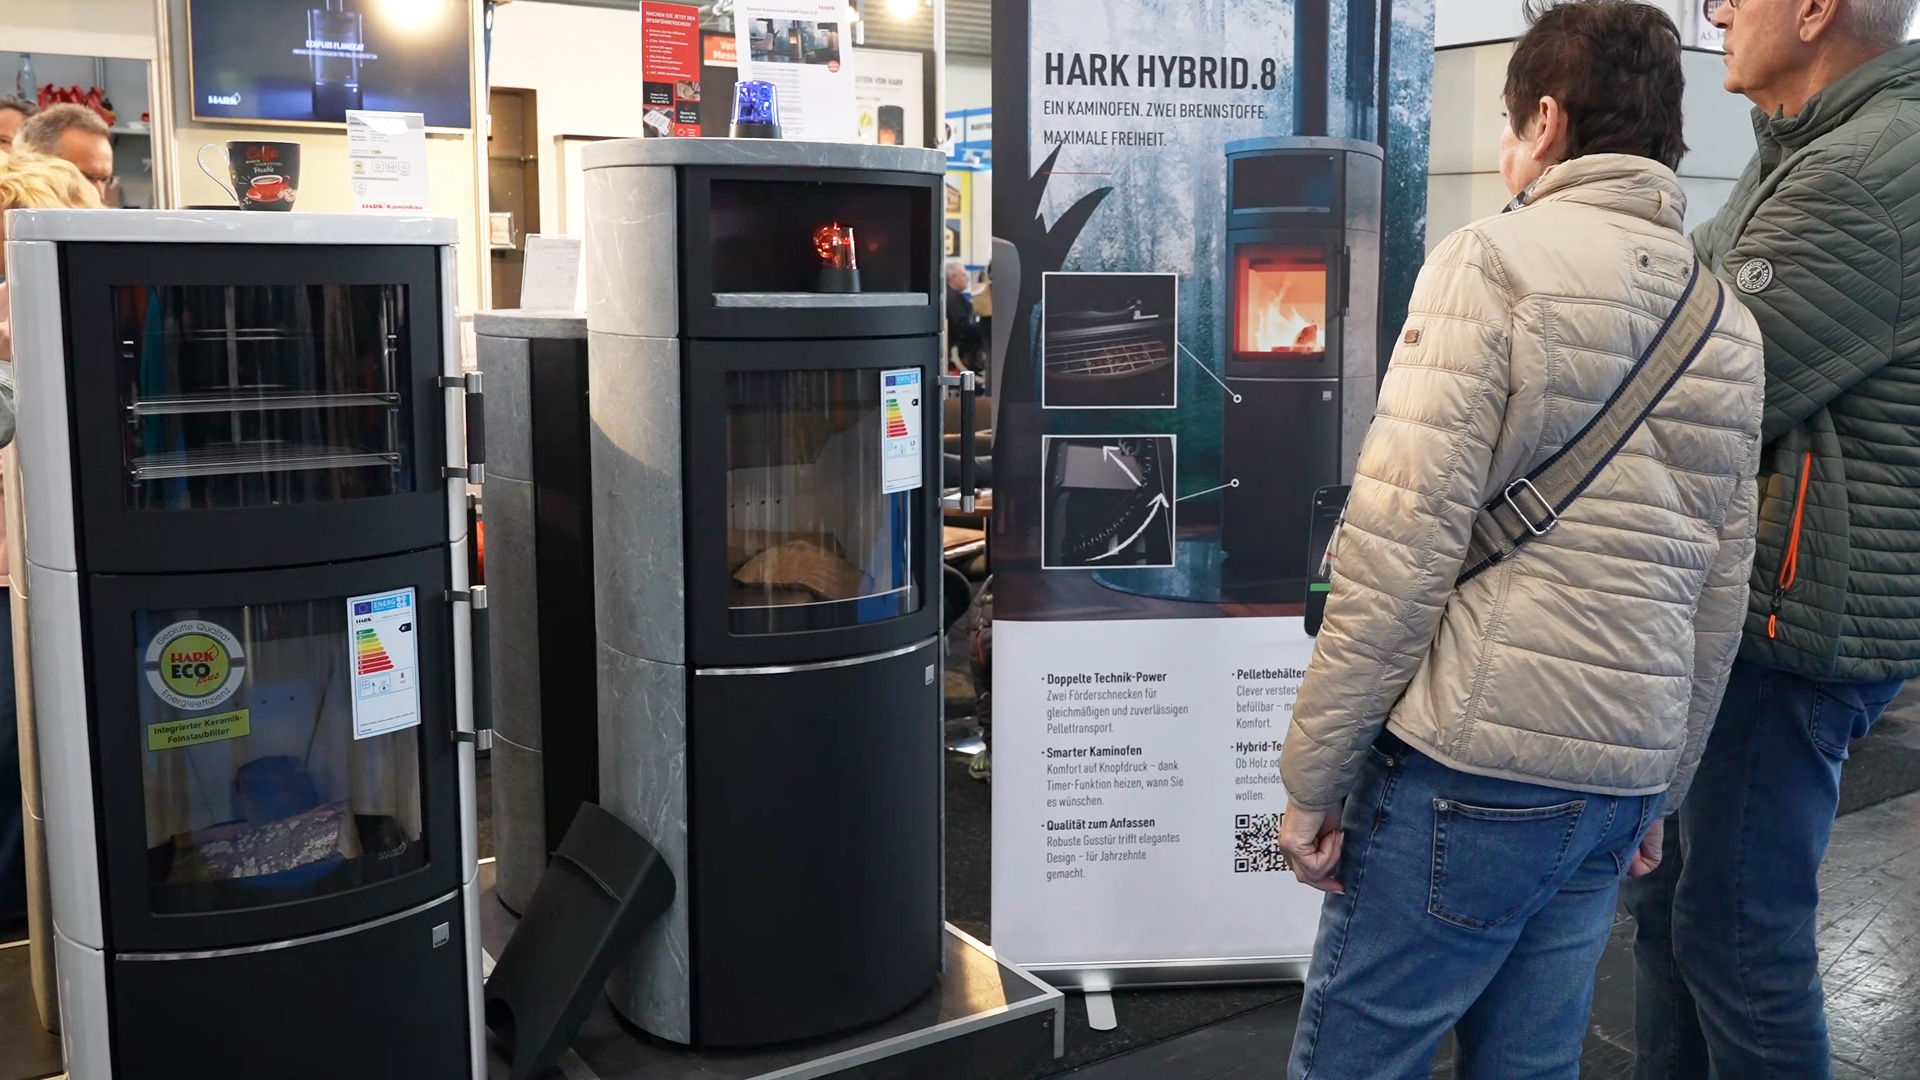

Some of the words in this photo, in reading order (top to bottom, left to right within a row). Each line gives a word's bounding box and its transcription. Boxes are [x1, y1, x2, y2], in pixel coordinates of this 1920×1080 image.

[1044, 52, 1130, 87] HARK
[1137, 54, 1277, 91] HYBRID.8
[1043, 100, 1064, 115] EIN
[1067, 100, 1143, 118] KAMINOFEN.
[1146, 102, 1176, 118] ZWEI
[1180, 103, 1268, 120] BRENNSTOFFE.
[1043, 130, 1108, 146] MAXIMALE
[1111, 131, 1167, 147] FREIHEIT.
[373, 598, 396, 610] ENERG
[157, 623, 194, 645] Geprüfte
[196, 623, 231, 643] Qualität
[170, 651, 215, 663] HARK
[171, 663, 211, 679] ECO
[1237, 668, 1306, 680] Pelletbehälter
[1047, 673, 1092, 687] Doppelte
[1094, 671, 1167, 684] Technik-Power
[161, 687, 231, 708] Energieeffizienz
[1046, 689, 1067, 701] Zwei
[1069, 688, 1143, 701] Förderschnecken
[1145, 687, 1157, 699] für
[1236, 684, 1263, 696] Clever
[1046, 705, 1110, 721] gleichmäßigen
[1112, 705, 1128, 716] und
[1129, 703, 1189, 718] zuverlässigen
[1236, 702, 1275, 713] befüllbar
[1284, 703, 1293, 712] m
[154, 722, 203, 735] Integrierter
[204, 714, 243, 727] Keramik-
[1047, 722, 1115, 736] Pellettransport.
[1236, 717, 1273, 729] Komfort.
[167, 728, 230, 744] Feinstaubfilter
[1046, 747, 1088, 759] Smarter
[1090, 745, 1142, 757] Kaminofen
[1236, 741, 1282, 755] Hybrid-Te
[1047, 763, 1082, 774] Komfort
[1083, 762, 1097, 774] auf
[1099, 761, 1148, 775] Knopfdruck
[1157, 760, 1179, 771] dank
[1235, 758, 1247, 769] Ob
[1249, 757, 1268, 768] Holz
[1047, 778, 1112, 791] Timer-Funktion
[1114, 778, 1144, 790] heizen,
[1145, 777, 1169, 788] wann
[1170, 775, 1184, 787] Sie
[1235, 773, 1281, 785] entscheide
[1046, 798, 1057, 807] es
[1059, 795, 1104, 807] wünschen.
[1235, 790, 1265, 801] wollen.
[1046, 819, 1086, 831] Qualität
[1088, 820, 1108, 830] zum
[1109, 818, 1155, 829] Anfassen
[1046, 835, 1081, 847] Robuste
[1083, 834, 1116, 846] Gusstür
[1118, 833, 1137, 845] trifft
[1139, 832, 1181, 846] elegantes
[1046, 852, 1076, 866] Design
[1086, 851, 1098, 862] für
[1099, 850, 1147, 862] Jahrzehnte
[1046, 867, 1086, 882] gemacht.
